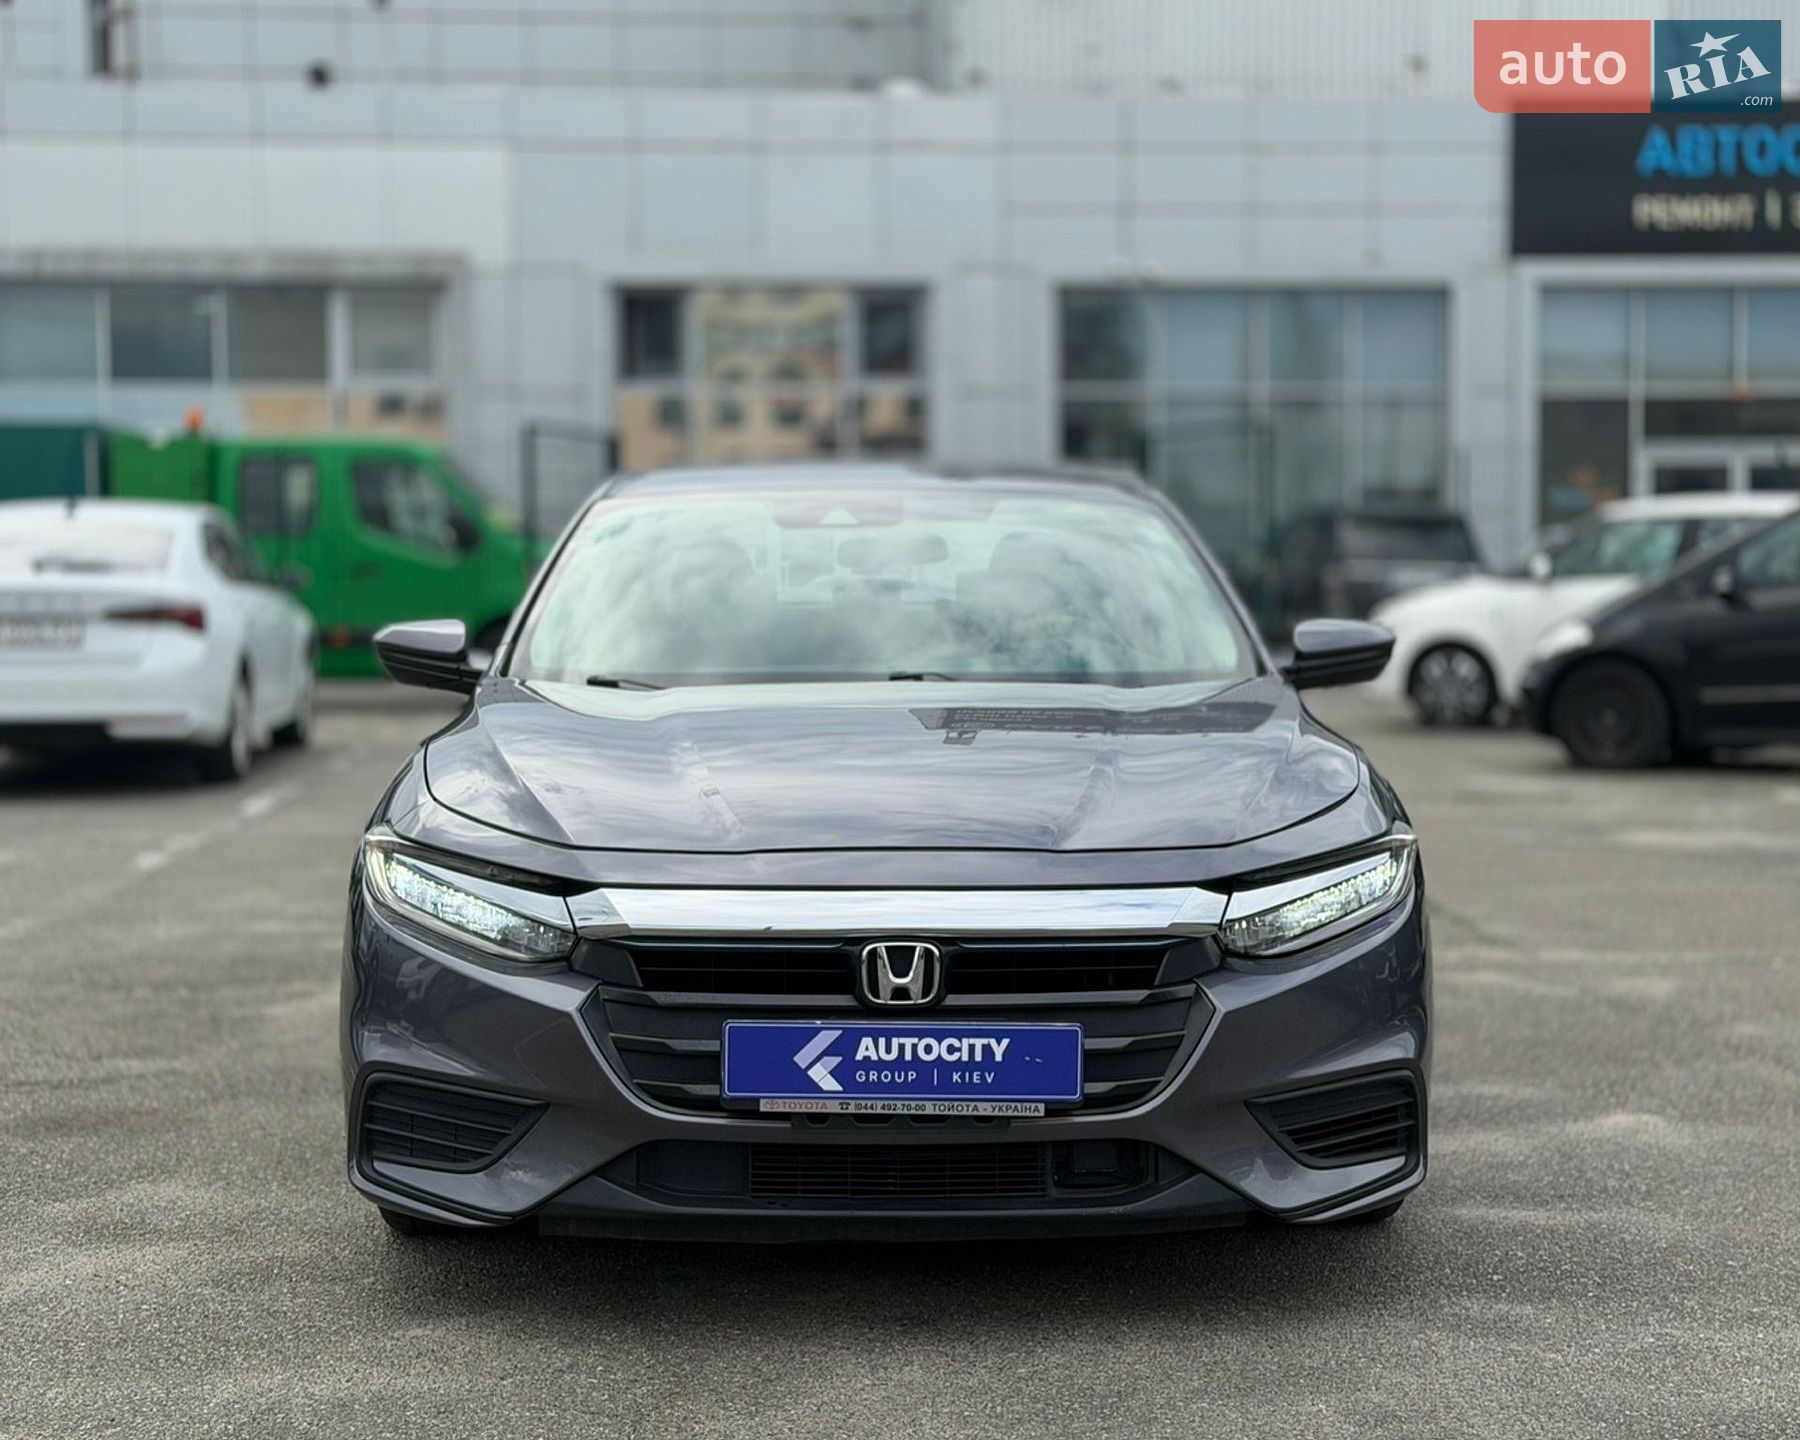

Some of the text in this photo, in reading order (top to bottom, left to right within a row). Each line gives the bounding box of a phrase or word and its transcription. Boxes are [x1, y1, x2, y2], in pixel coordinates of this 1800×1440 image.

[855, 1037, 1010, 1062] AUTOCITY
[855, 1070, 996, 1083] GROUP KIEV
[782, 1101, 828, 1110] TOYOTA
[854, 1102, 878, 1112] (044)
[880, 1102, 926, 1112] 492-70-00
[931, 1102, 980, 1113] ТОЙОТА
[991, 1103, 1041, 1114] УКРАЇНА
